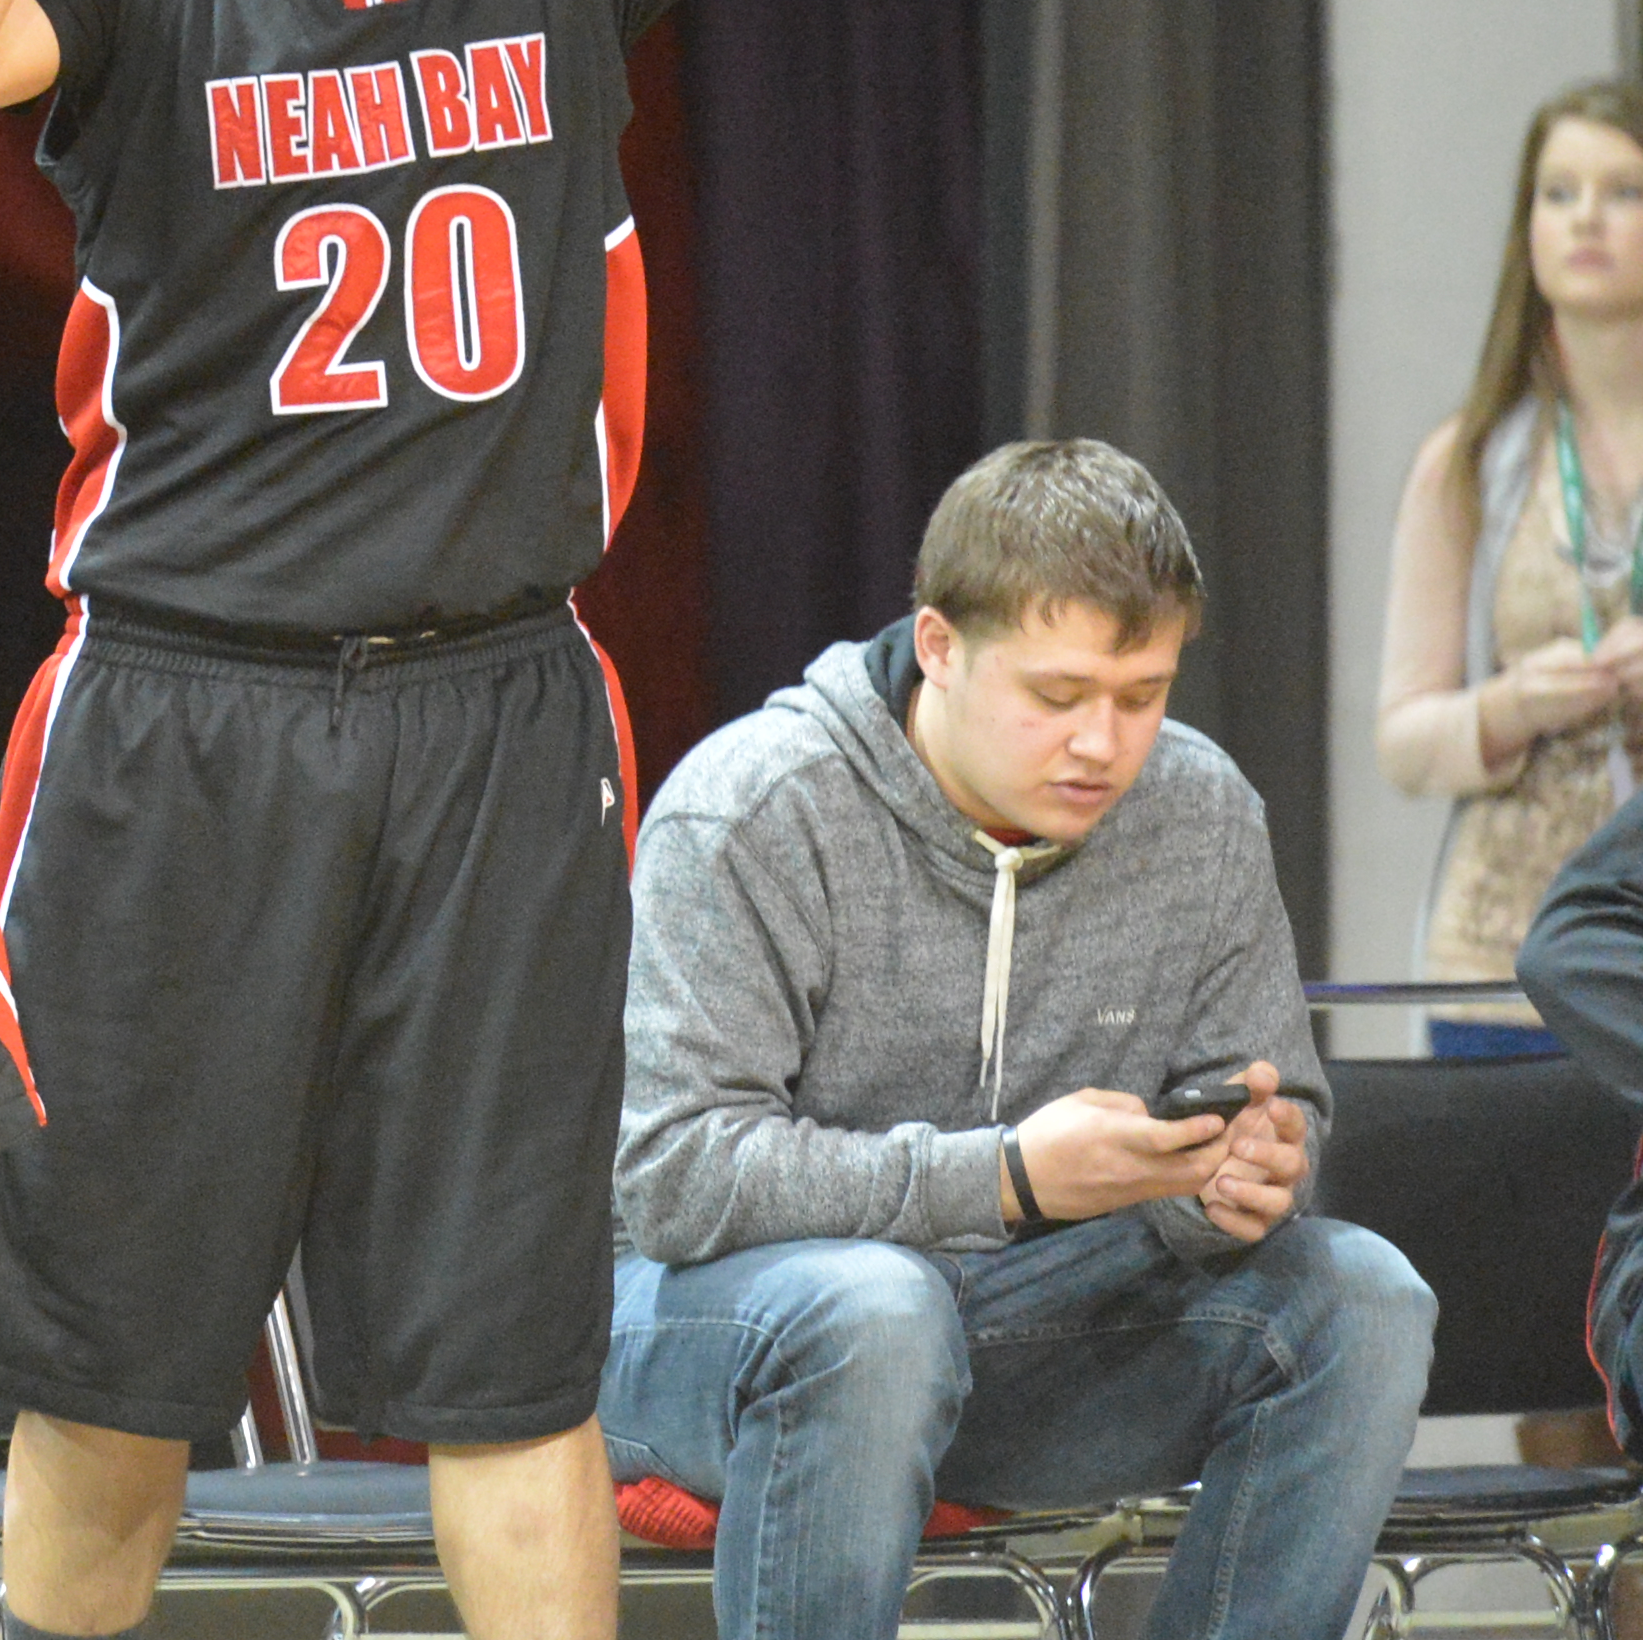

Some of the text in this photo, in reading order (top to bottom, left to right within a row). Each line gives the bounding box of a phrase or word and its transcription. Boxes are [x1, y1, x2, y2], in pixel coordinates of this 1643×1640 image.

[205, 33, 552, 189] NEAH BAY
[271, 183, 525, 415] 20
[1096, 1005, 1136, 1026] VANS
